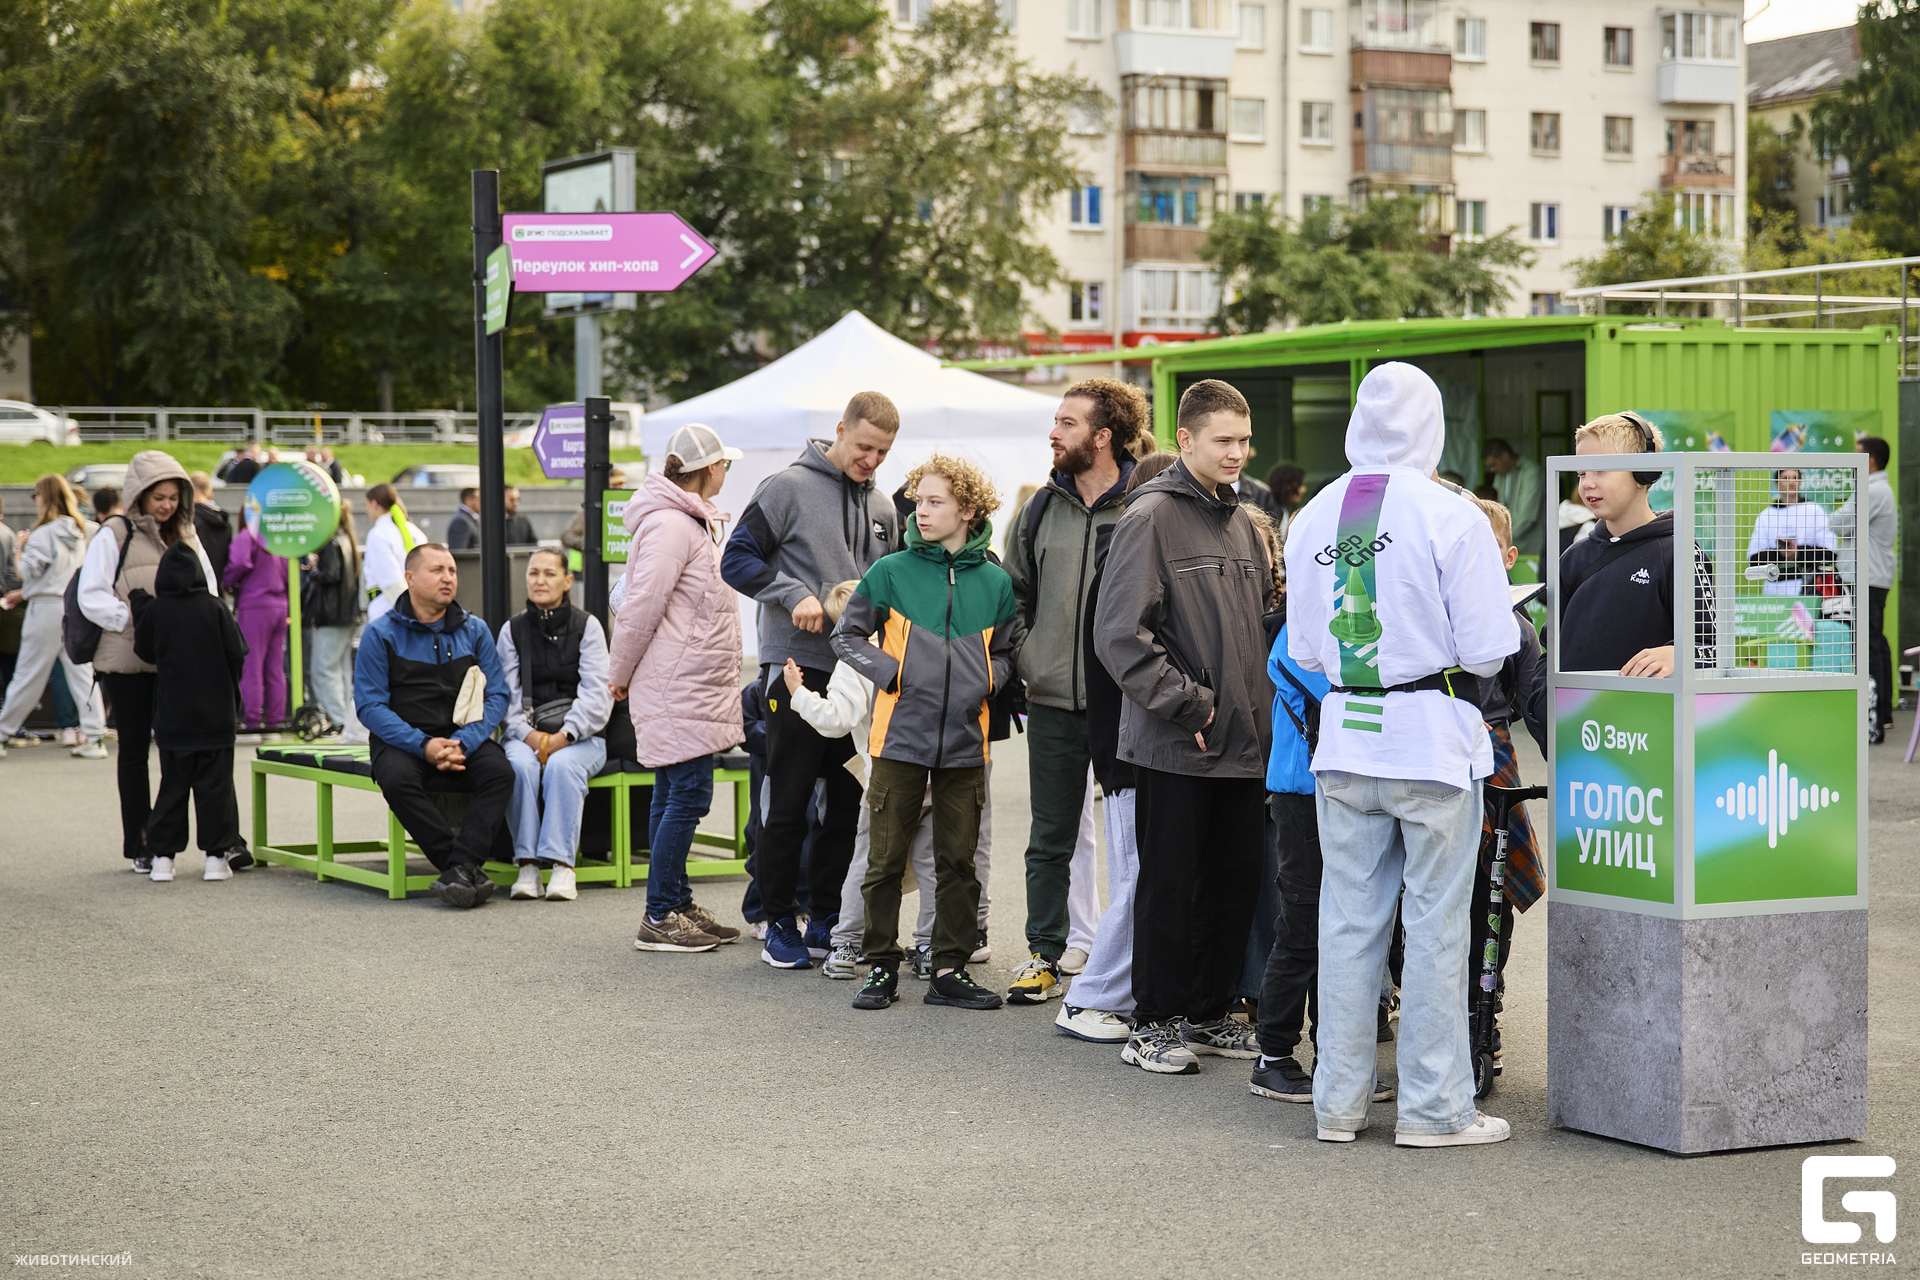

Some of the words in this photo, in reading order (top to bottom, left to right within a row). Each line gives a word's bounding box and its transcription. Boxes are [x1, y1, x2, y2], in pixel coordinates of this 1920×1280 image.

[547, 229, 609, 237] ПОДСКАЗЫВАЕТ
[513, 259, 586, 275] Переулок
[589, 260, 659, 273] хип-хопа
[562, 439, 585, 454] Кварта
[550, 457, 585, 469] активносте
[607, 522, 632, 538] Улиц
[1314, 534, 1363, 567] Сбер
[1344, 531, 1393, 568] Спот
[1630, 573, 1650, 585] Kappa
[1603, 725, 1649, 755] Звук
[1569, 781, 1663, 826] ГОЛОС
[1575, 826, 1656, 878] УЛИЦ
